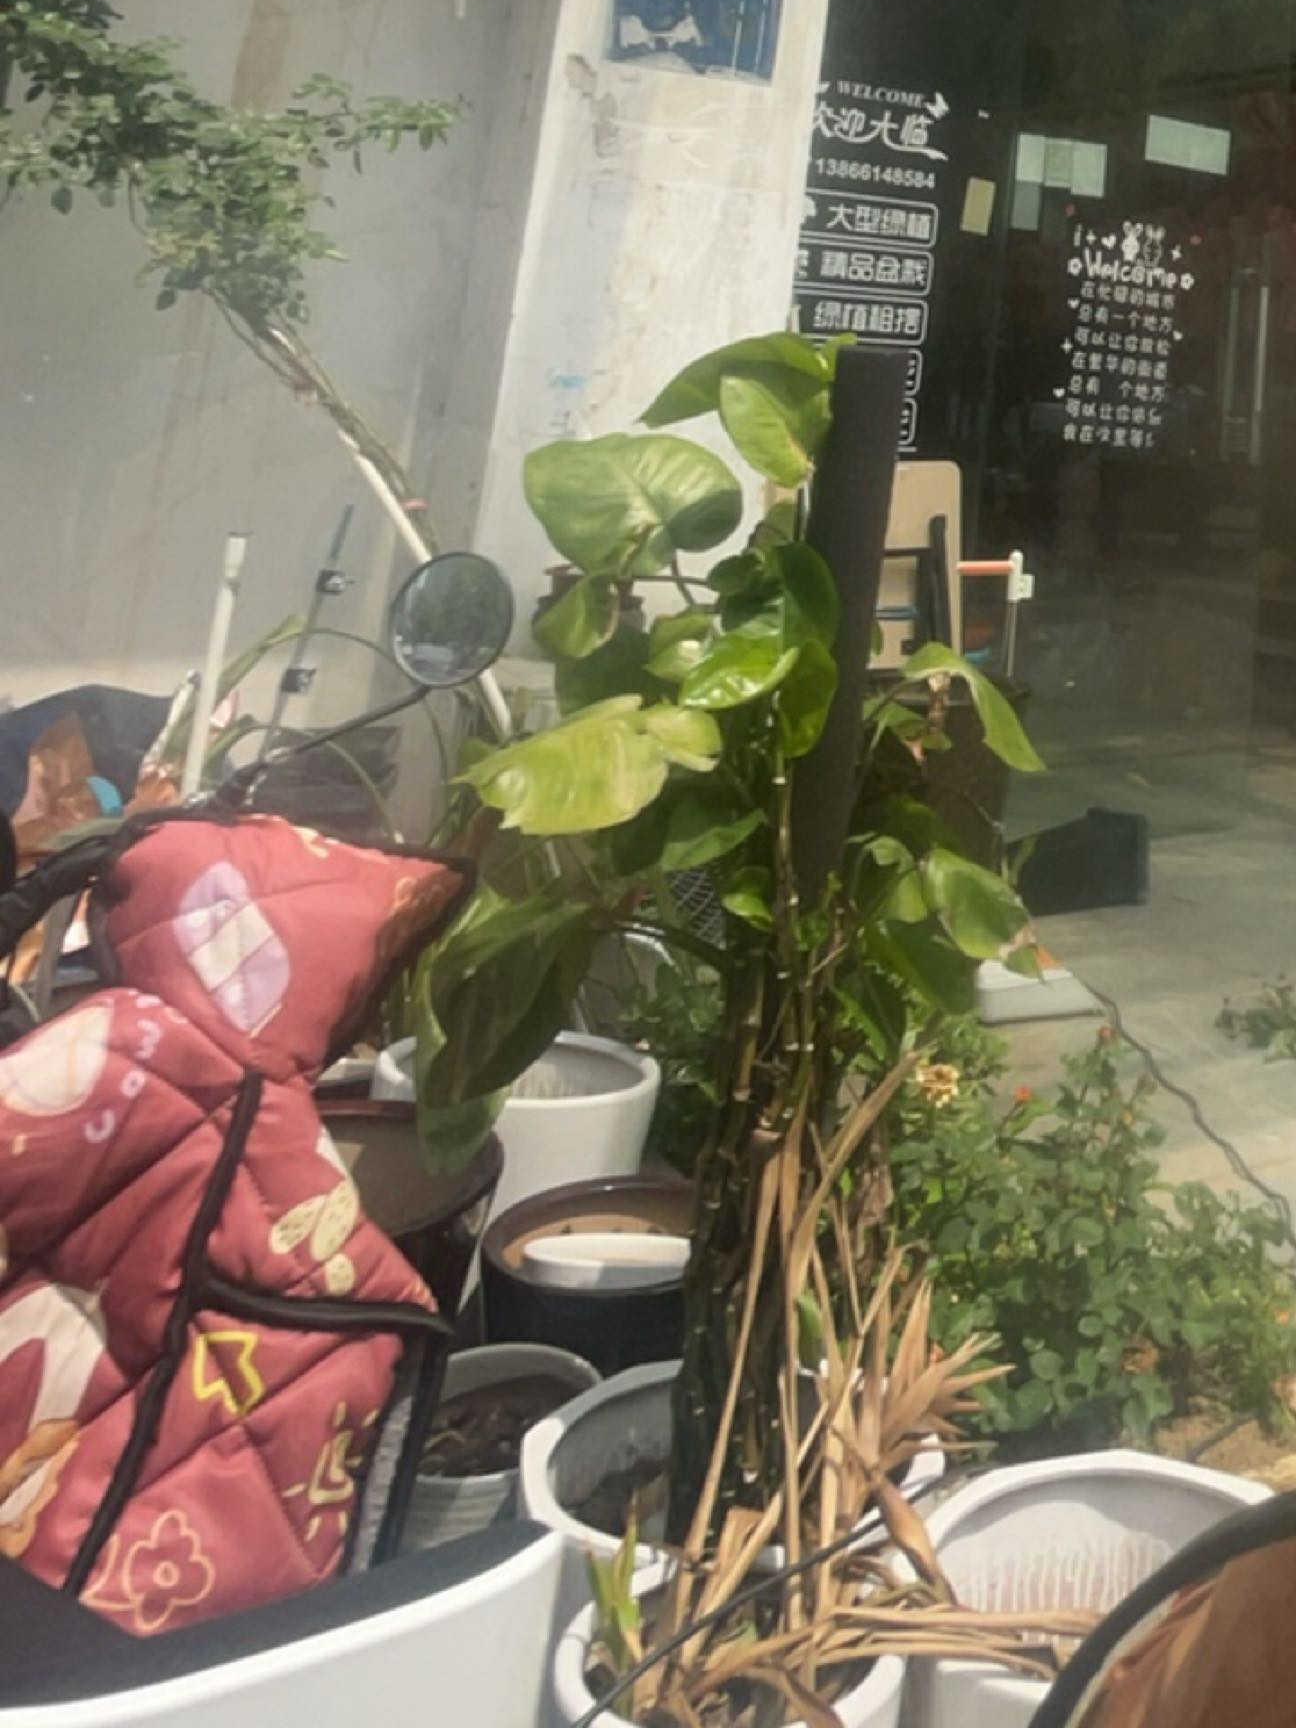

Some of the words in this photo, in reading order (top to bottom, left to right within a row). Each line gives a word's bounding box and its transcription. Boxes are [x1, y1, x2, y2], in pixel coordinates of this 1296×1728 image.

[837, 80, 926, 109] WELCOME
[820, 249, 928, 286] 精品盆栽
[1084, 246, 1178, 289] Welcome
[1077, 303, 1174, 334] 总有一个地方
[1067, 374, 1165, 403] 总有个地方
